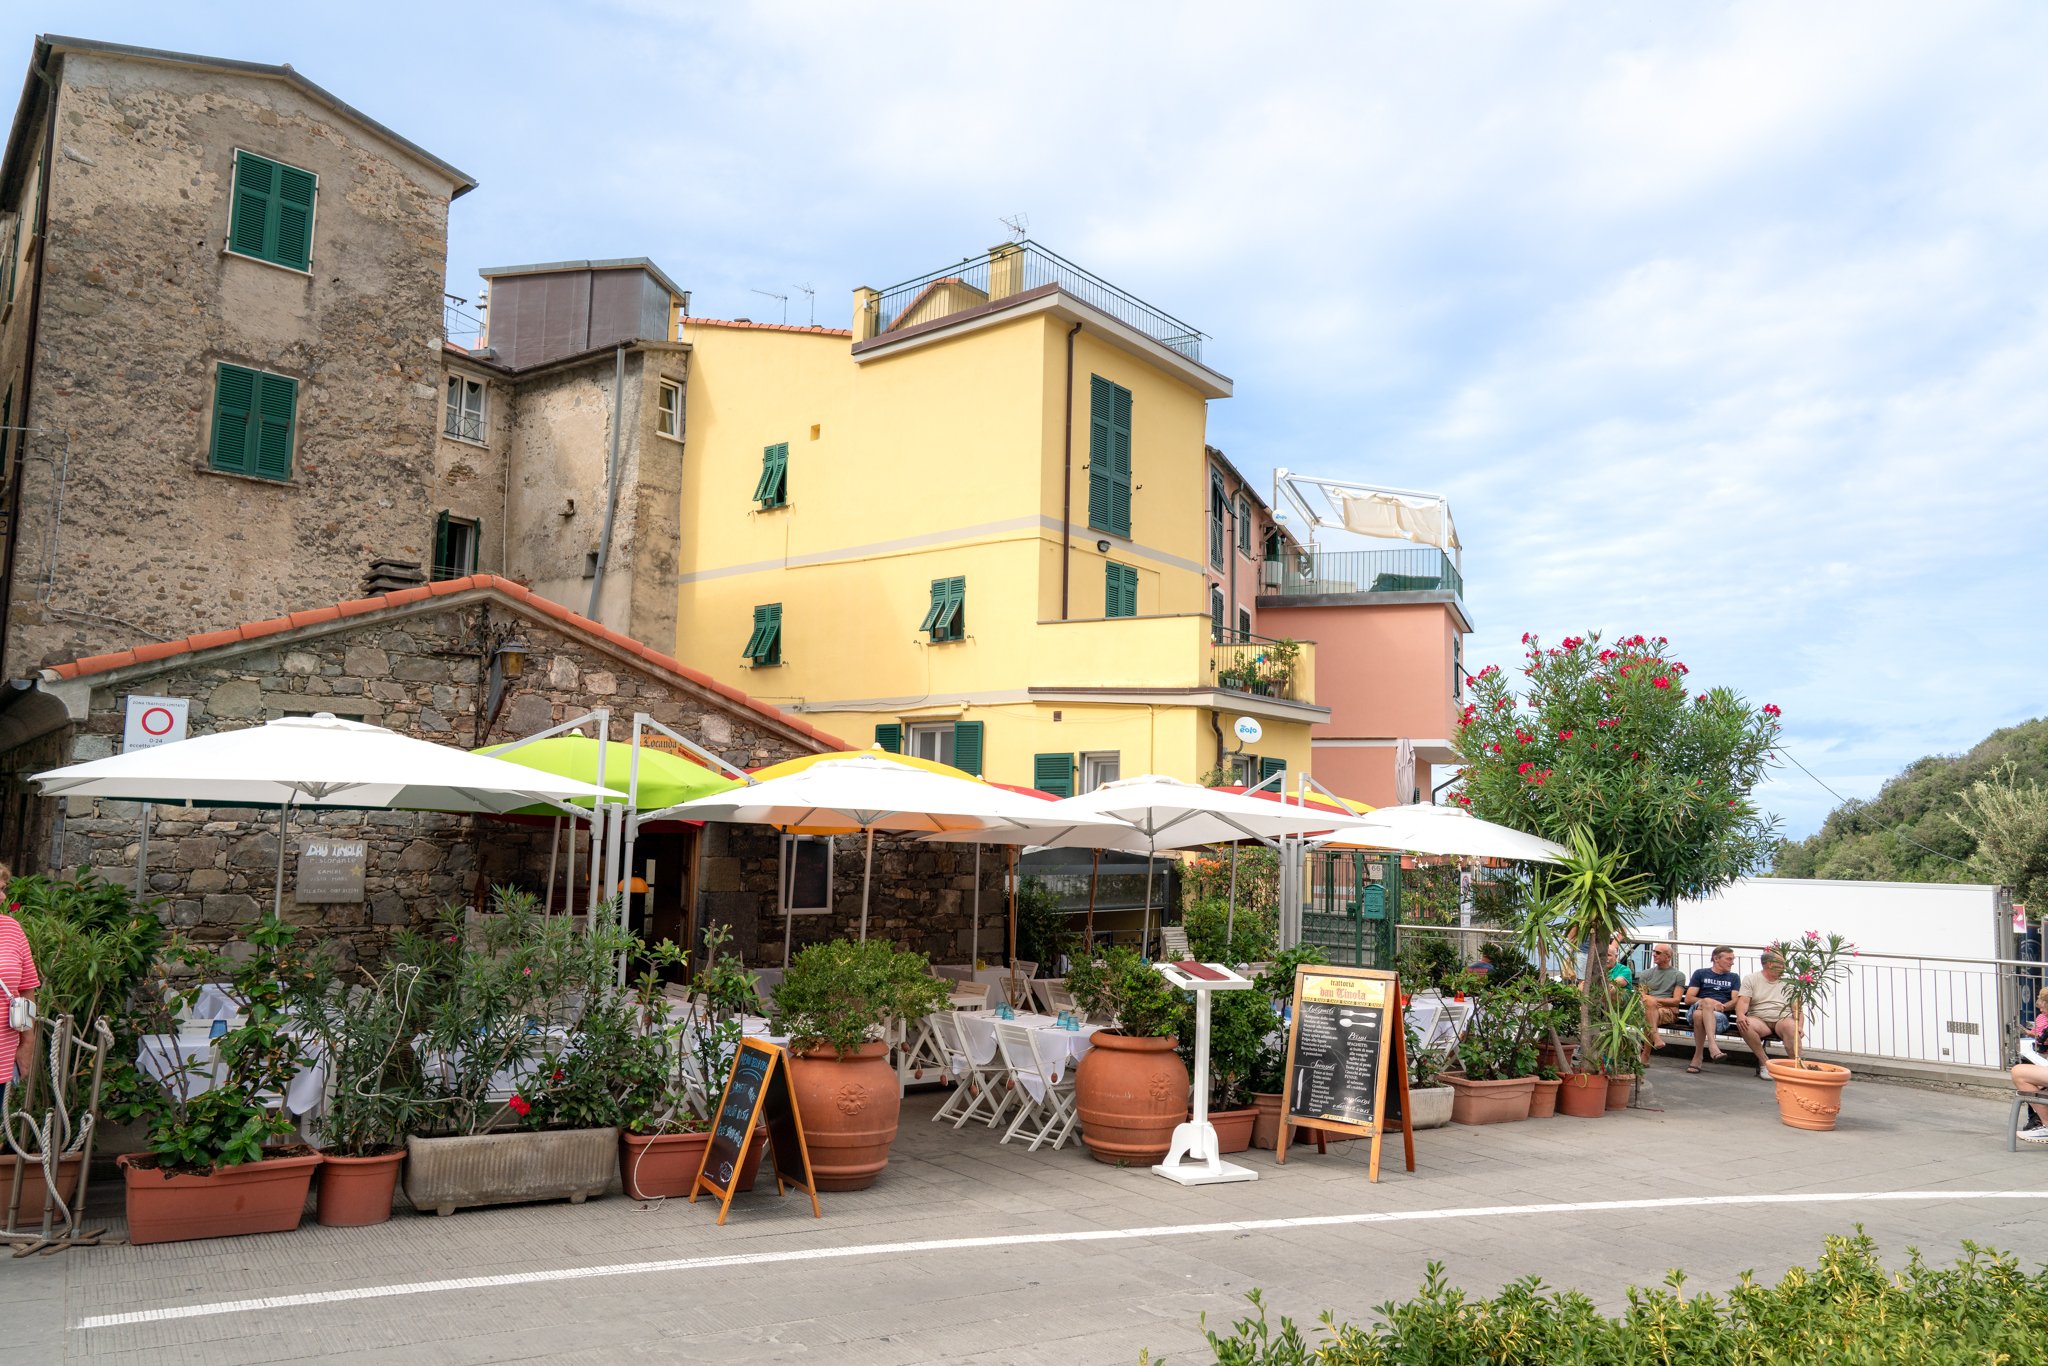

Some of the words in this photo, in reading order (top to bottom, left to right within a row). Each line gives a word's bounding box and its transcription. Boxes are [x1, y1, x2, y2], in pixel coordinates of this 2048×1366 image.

[643, 737, 676, 748] Locanda
[1330, 979, 1355, 988] trattoria
[1704, 978, 1731, 987] HOLLISTER
[1336, 987, 1366, 1000] Tinola
